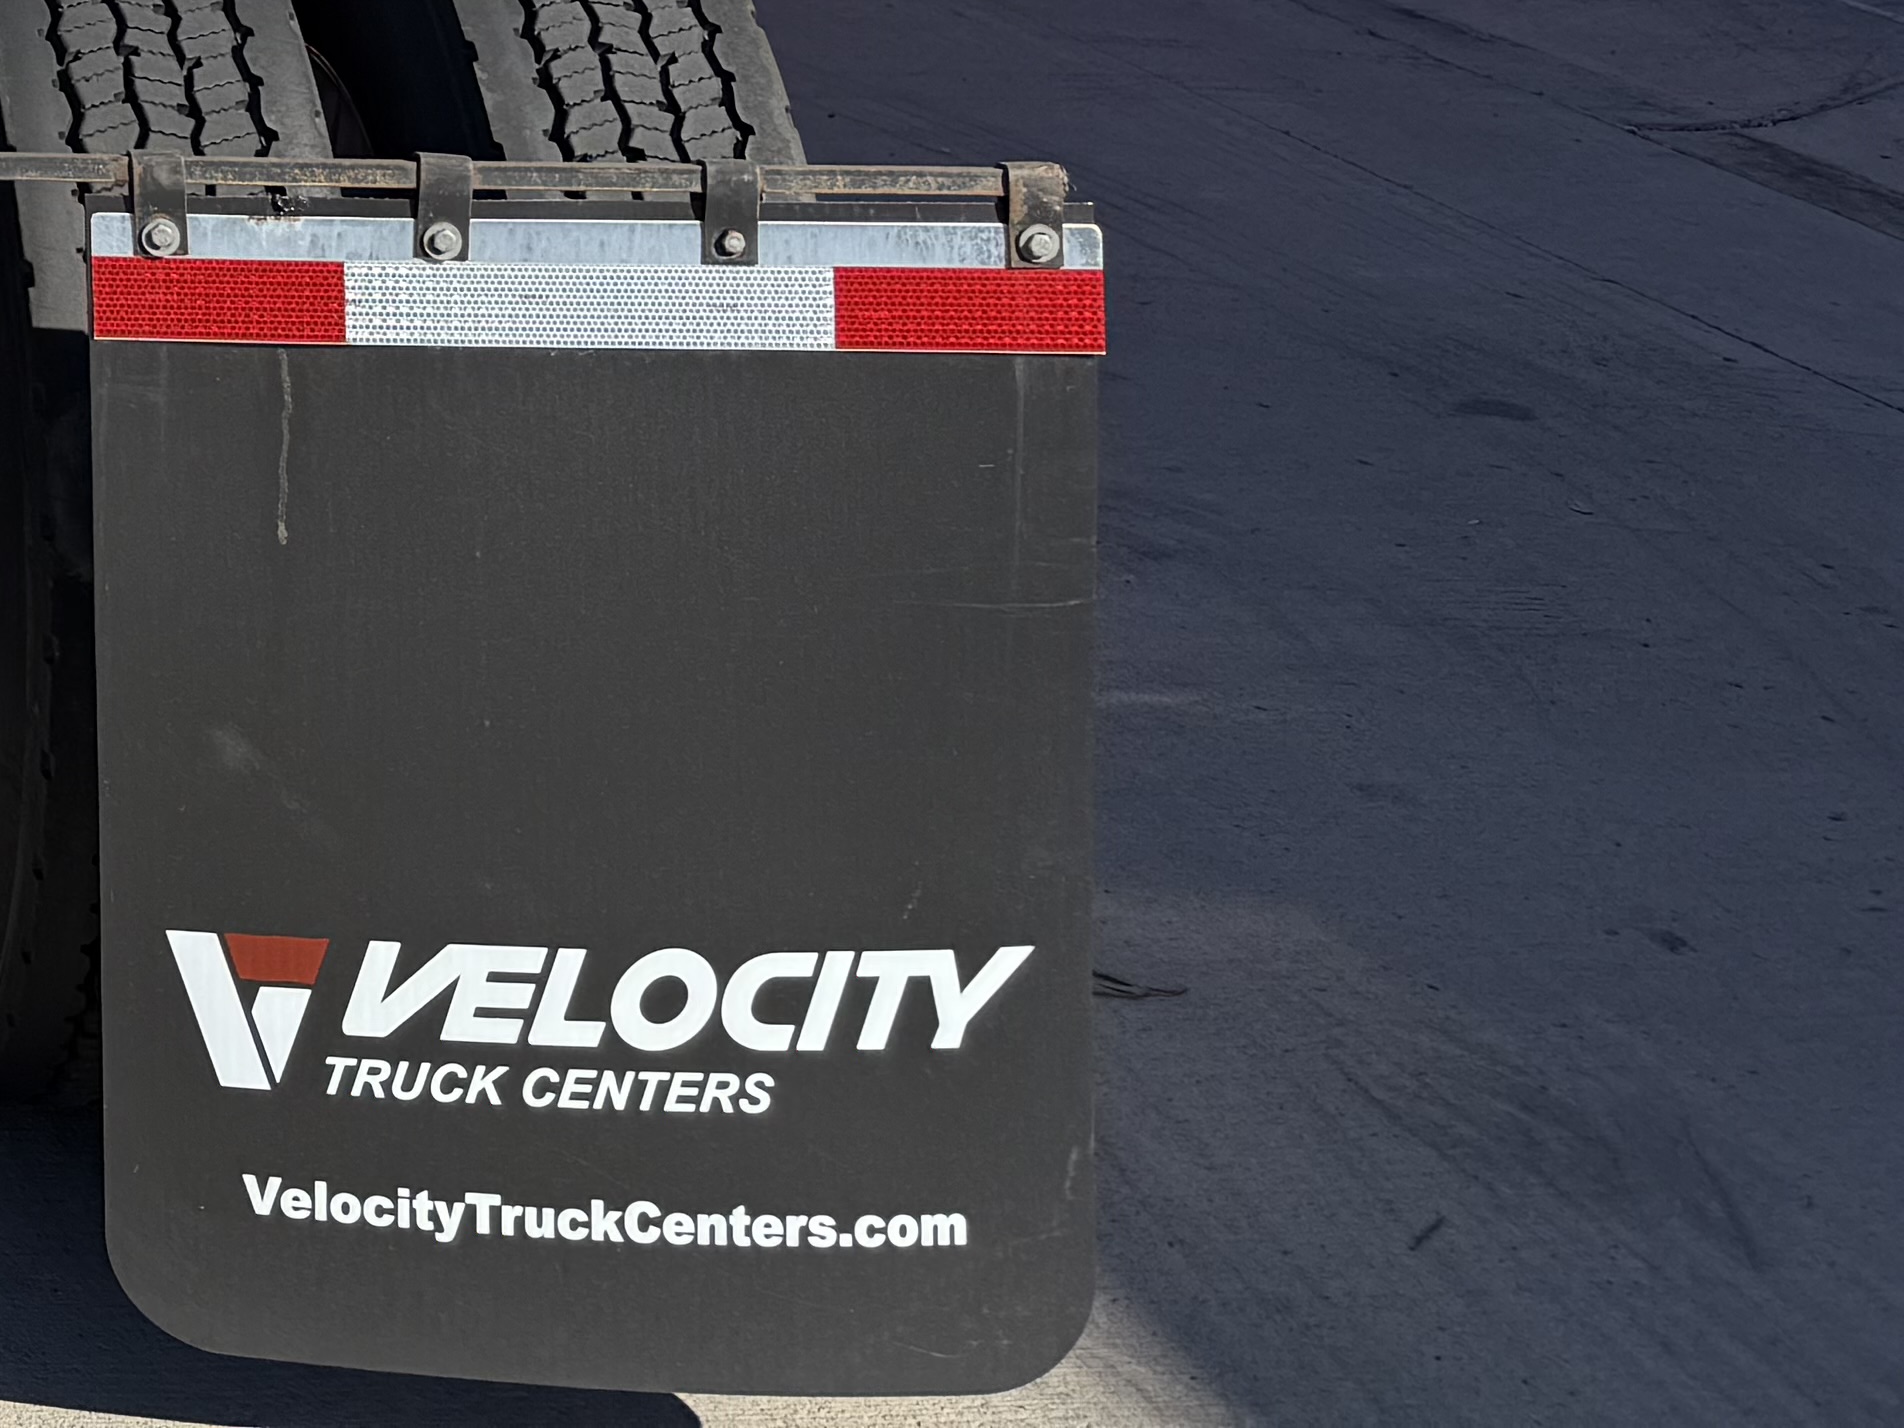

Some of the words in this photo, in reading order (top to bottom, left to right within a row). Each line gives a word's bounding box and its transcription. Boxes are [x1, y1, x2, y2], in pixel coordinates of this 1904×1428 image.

[342, 941, 1035, 1052] VELOCITY
[325, 1057, 510, 1106] TRUCK
[522, 1068, 775, 1114] CENTERS
[242, 1174, 968, 1249] VelocityTruckCenters.com
